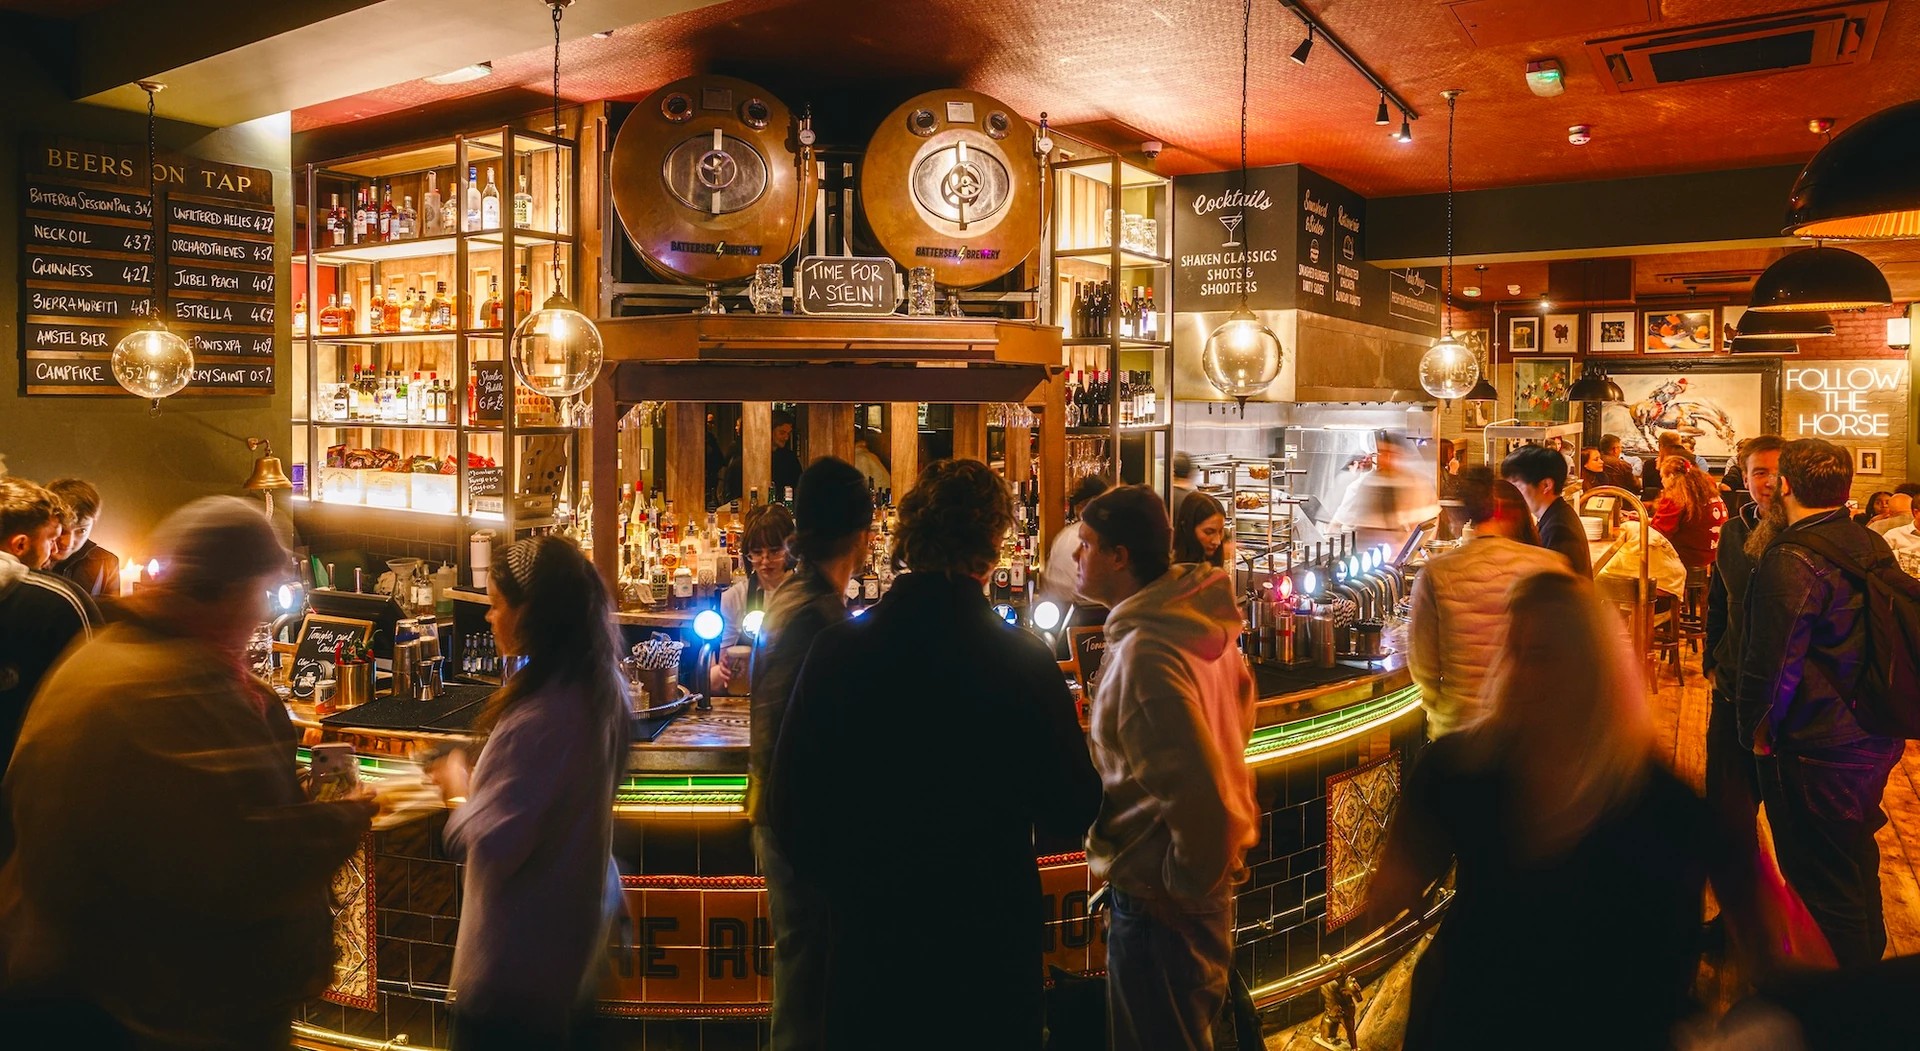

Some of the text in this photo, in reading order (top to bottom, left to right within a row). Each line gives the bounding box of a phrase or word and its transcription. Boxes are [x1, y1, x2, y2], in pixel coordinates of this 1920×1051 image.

[47, 148, 252, 193] BEERS ON TAP
[1192, 188, 1273, 216] Cocktails
[34, 224, 67, 241] NECK
[69, 229, 92, 244] OIL
[670, 240, 763, 257] BATTERSEA BREWERY
[915, 246, 1001, 261] BATTERSEA BREWERY
[1181, 249, 1277, 267] SHAKEN CLASSICS
[32, 257, 94, 279] GUINNESS
[805, 260, 884, 282] TIME FOR
[1207, 266, 1255, 282] SHOTS &
[173, 269, 208, 288] JUBEL
[211, 274, 240, 290] PEACH
[1200, 281, 1258, 296] SHOOTERS
[808, 284, 882, 307] A STEIN!
[176, 302, 233, 321] ESTRELLA
[36, 330, 77, 346] AMSTEL
[80, 331, 109, 347] BIER
[36, 362, 105, 382] CAMPFIRE
[212, 367, 246, 384] SAINT
[1786, 367, 1902, 391] FOLLOW
[1820, 391, 1868, 413] THE
[1799, 414, 1889, 436] HORSE
